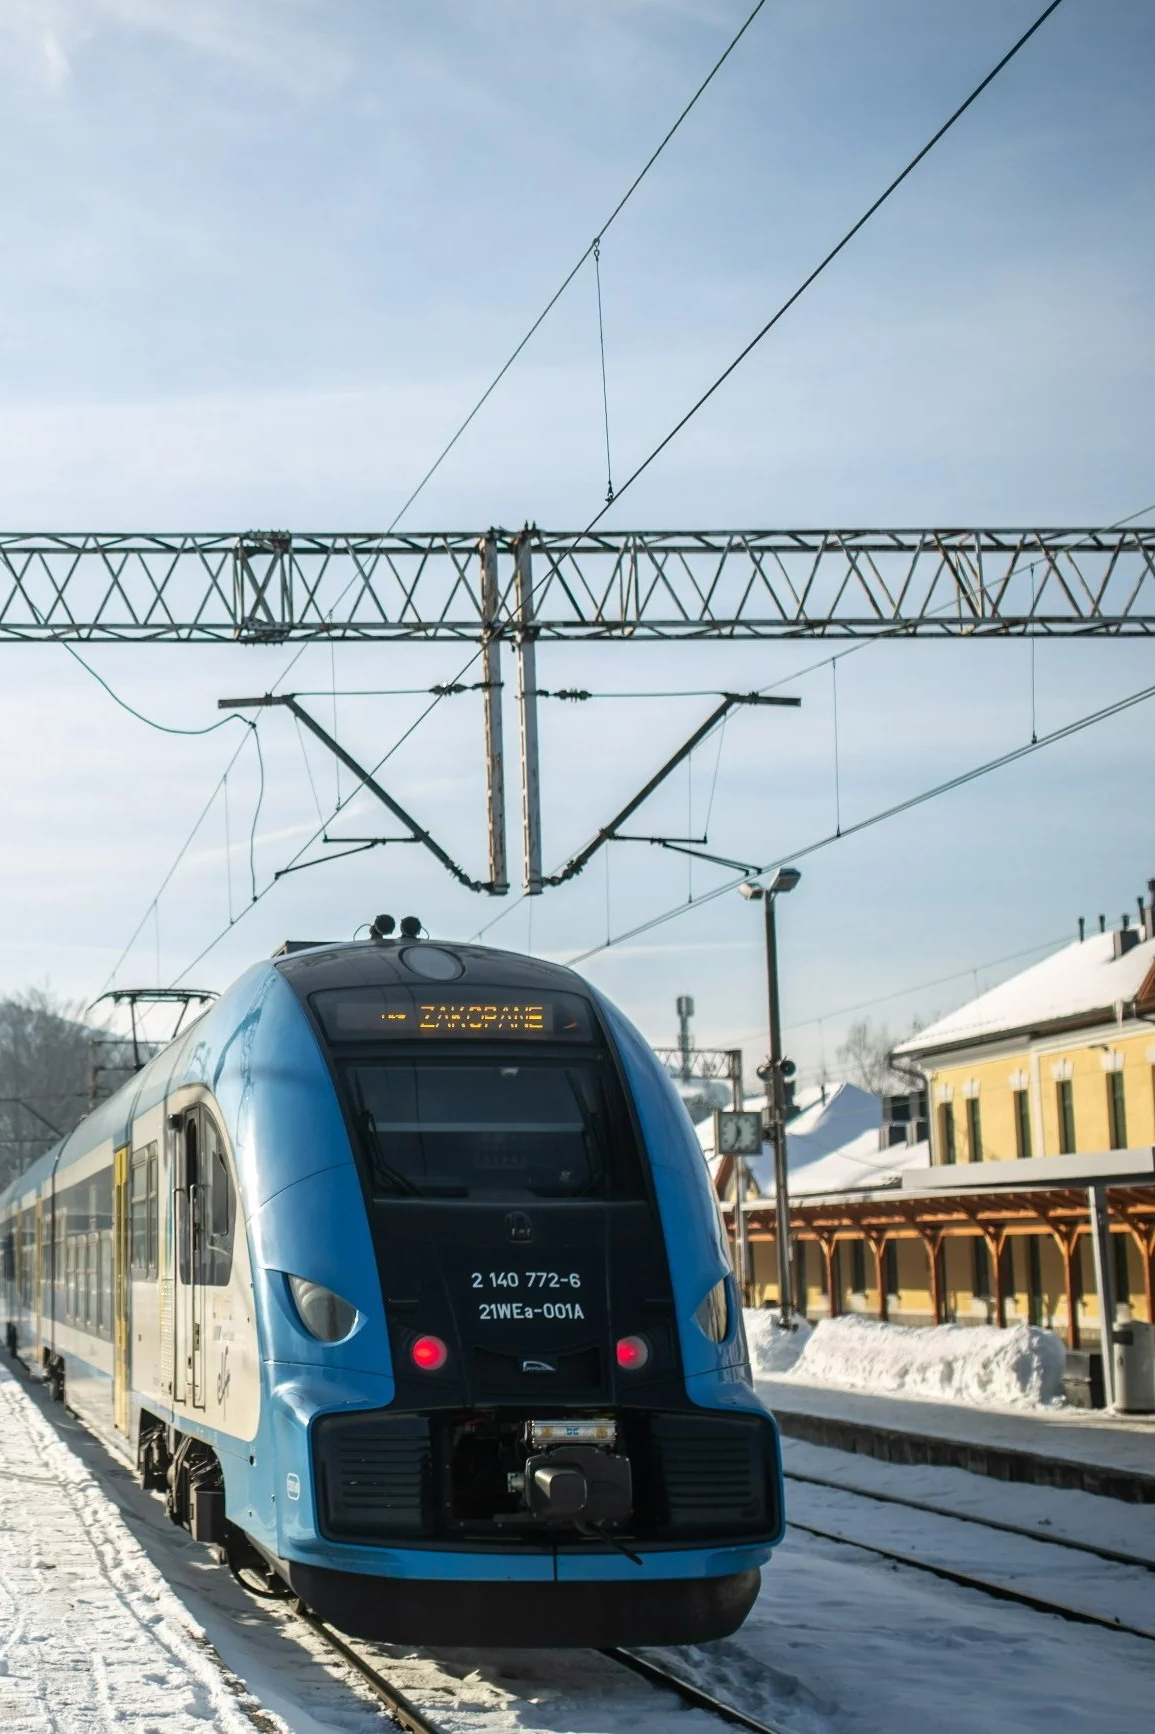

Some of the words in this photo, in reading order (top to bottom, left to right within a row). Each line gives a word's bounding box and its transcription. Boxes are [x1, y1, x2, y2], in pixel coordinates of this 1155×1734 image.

[419, 1006, 544, 1028] ZAKOPANE
[471, 1272, 483, 1288] 2
[489, 1272, 519, 1288] 140
[526, 1272, 581, 1288] 772-6
[479, 1303, 585, 1320] 21WEa-001A
